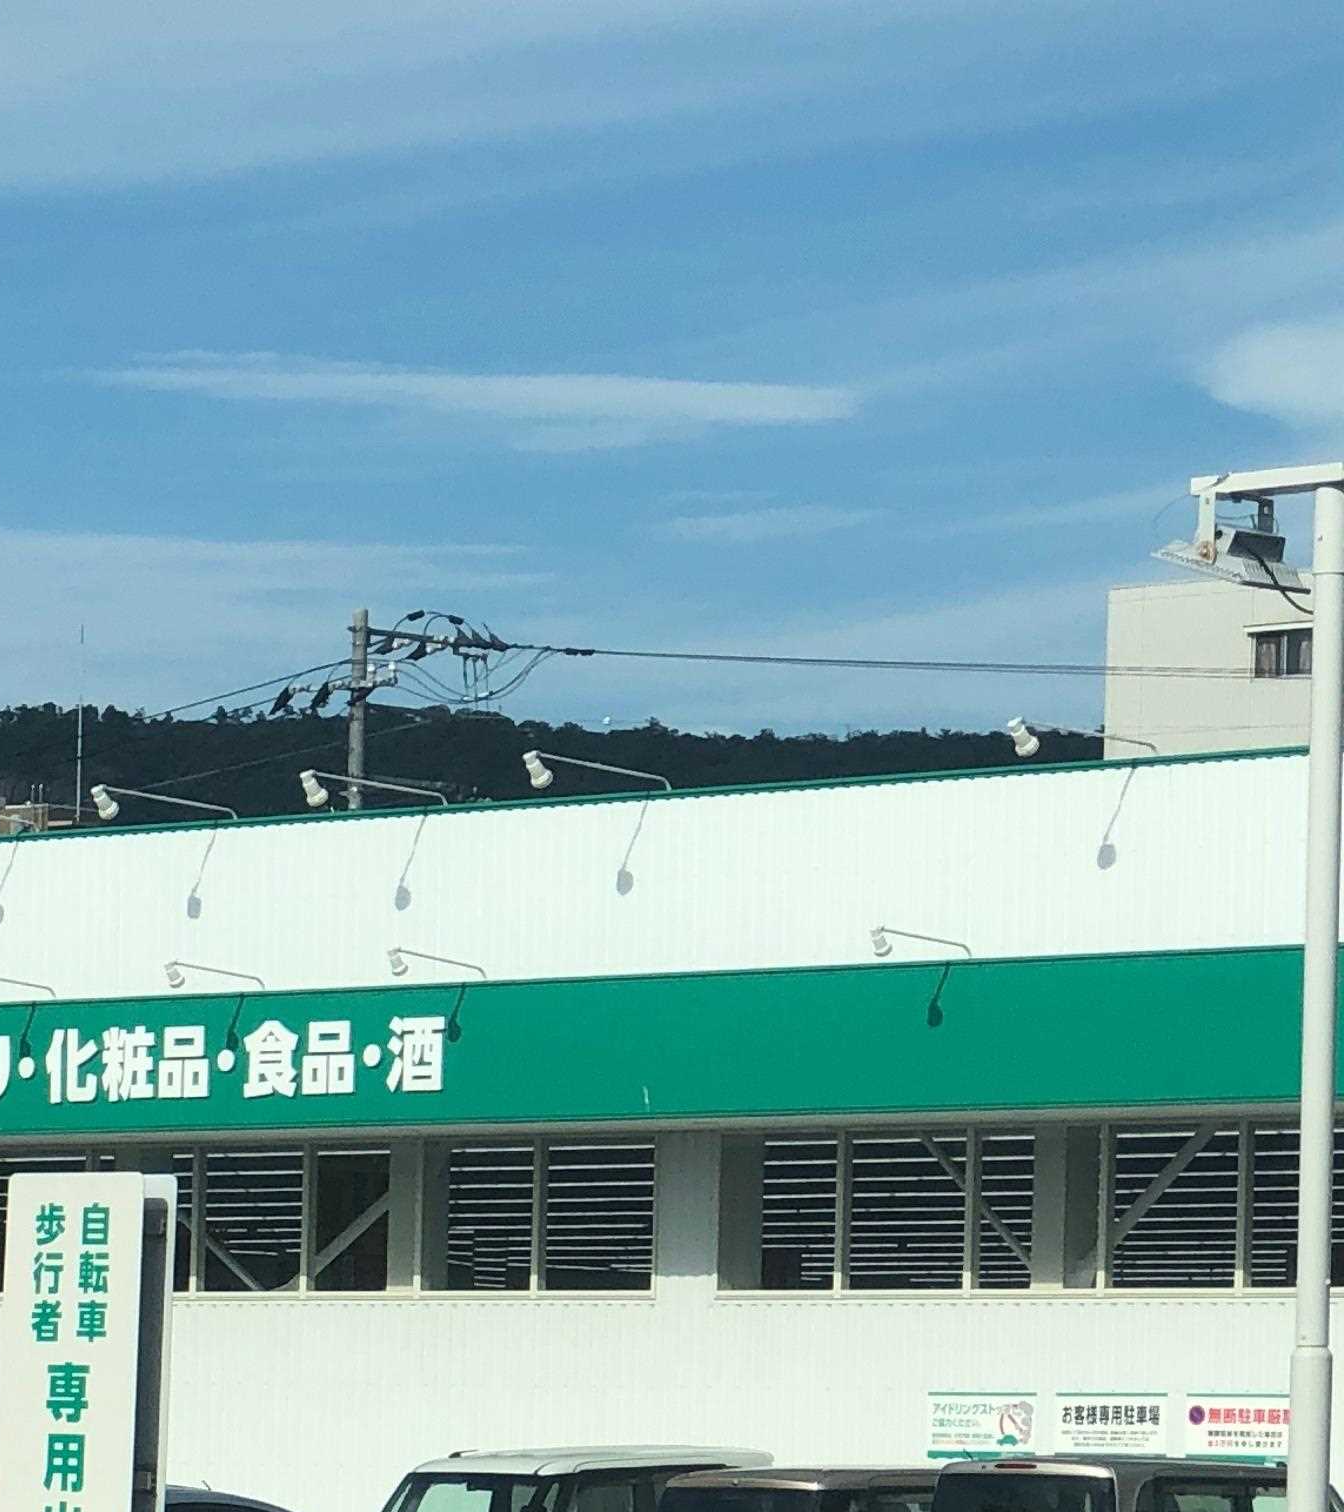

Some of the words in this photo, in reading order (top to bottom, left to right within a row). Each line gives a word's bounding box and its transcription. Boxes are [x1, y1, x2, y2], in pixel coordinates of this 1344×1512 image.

[31, 1202, 65, 1342] 歩行者
[76, 1202, 110, 1343] 自転車
[1062, 1405, 1160, 1426] お客様専用駐車場
